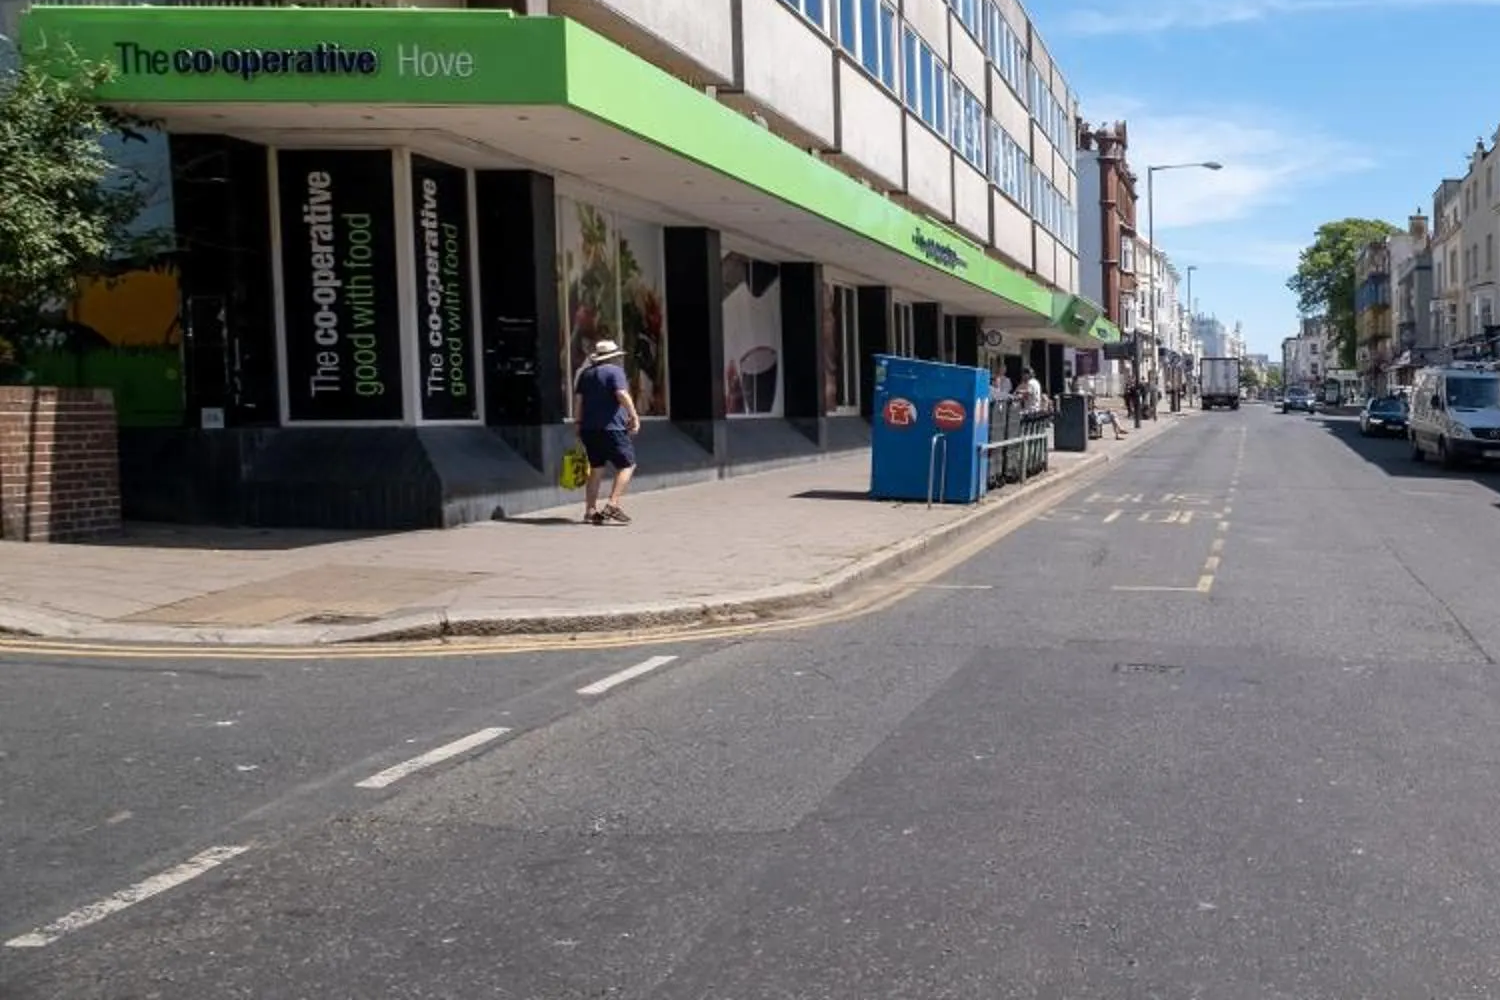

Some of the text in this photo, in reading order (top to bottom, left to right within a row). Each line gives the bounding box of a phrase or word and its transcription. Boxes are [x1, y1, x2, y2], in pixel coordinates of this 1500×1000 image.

[115, 42, 169, 74] The
[399, 44, 474, 77] Hove
[340, 213, 385, 397] good with food
[440, 223, 467, 397] good with food
[310, 351, 341, 397] The
[427, 353, 445, 397] The
